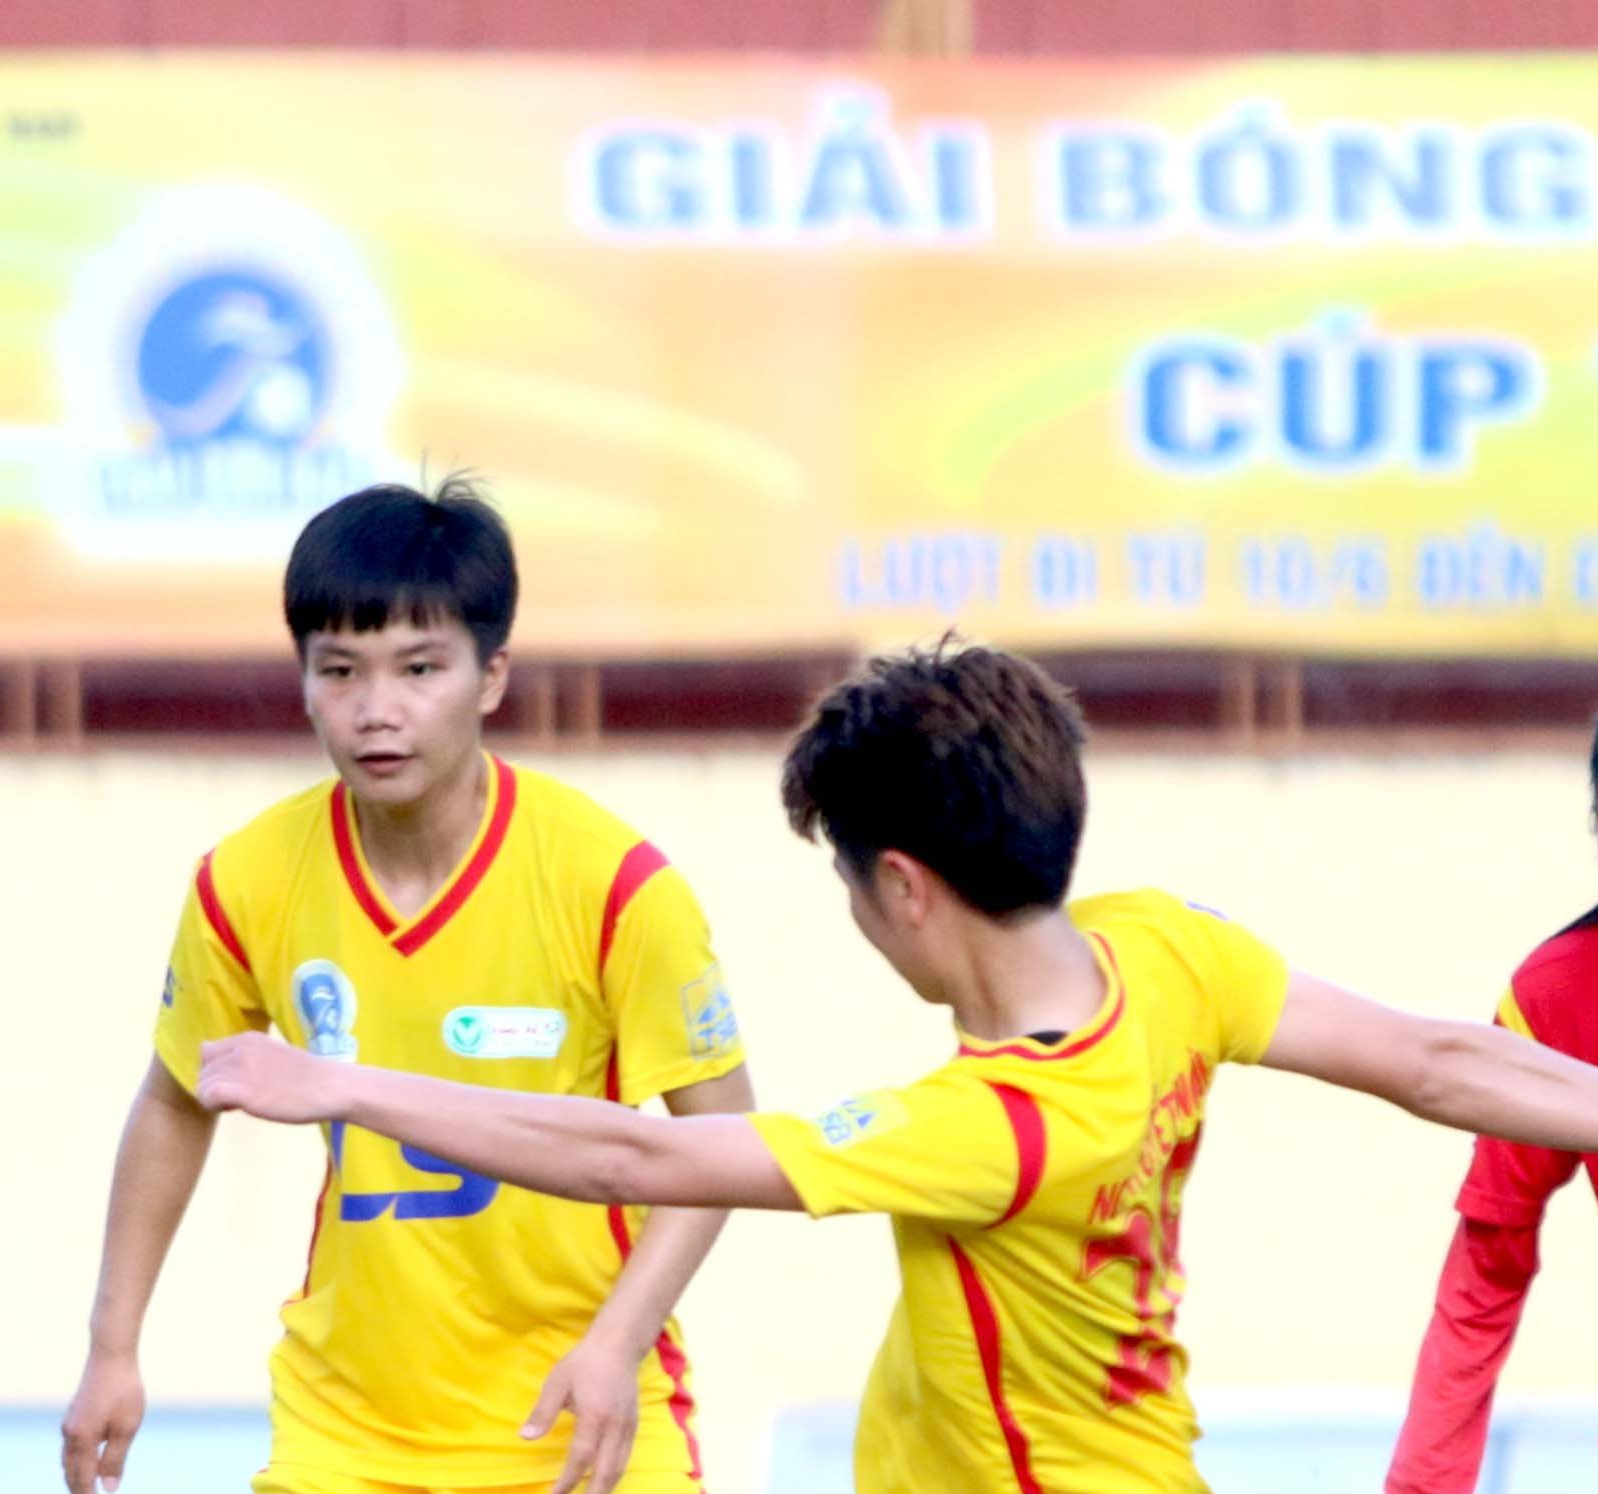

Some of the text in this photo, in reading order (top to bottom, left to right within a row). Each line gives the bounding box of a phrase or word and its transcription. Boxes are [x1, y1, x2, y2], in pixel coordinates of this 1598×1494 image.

[593, 96, 981, 230] GIẢI
[1059, 108, 1593, 230] BÓNG
[1142, 318, 1533, 462] CÚP
